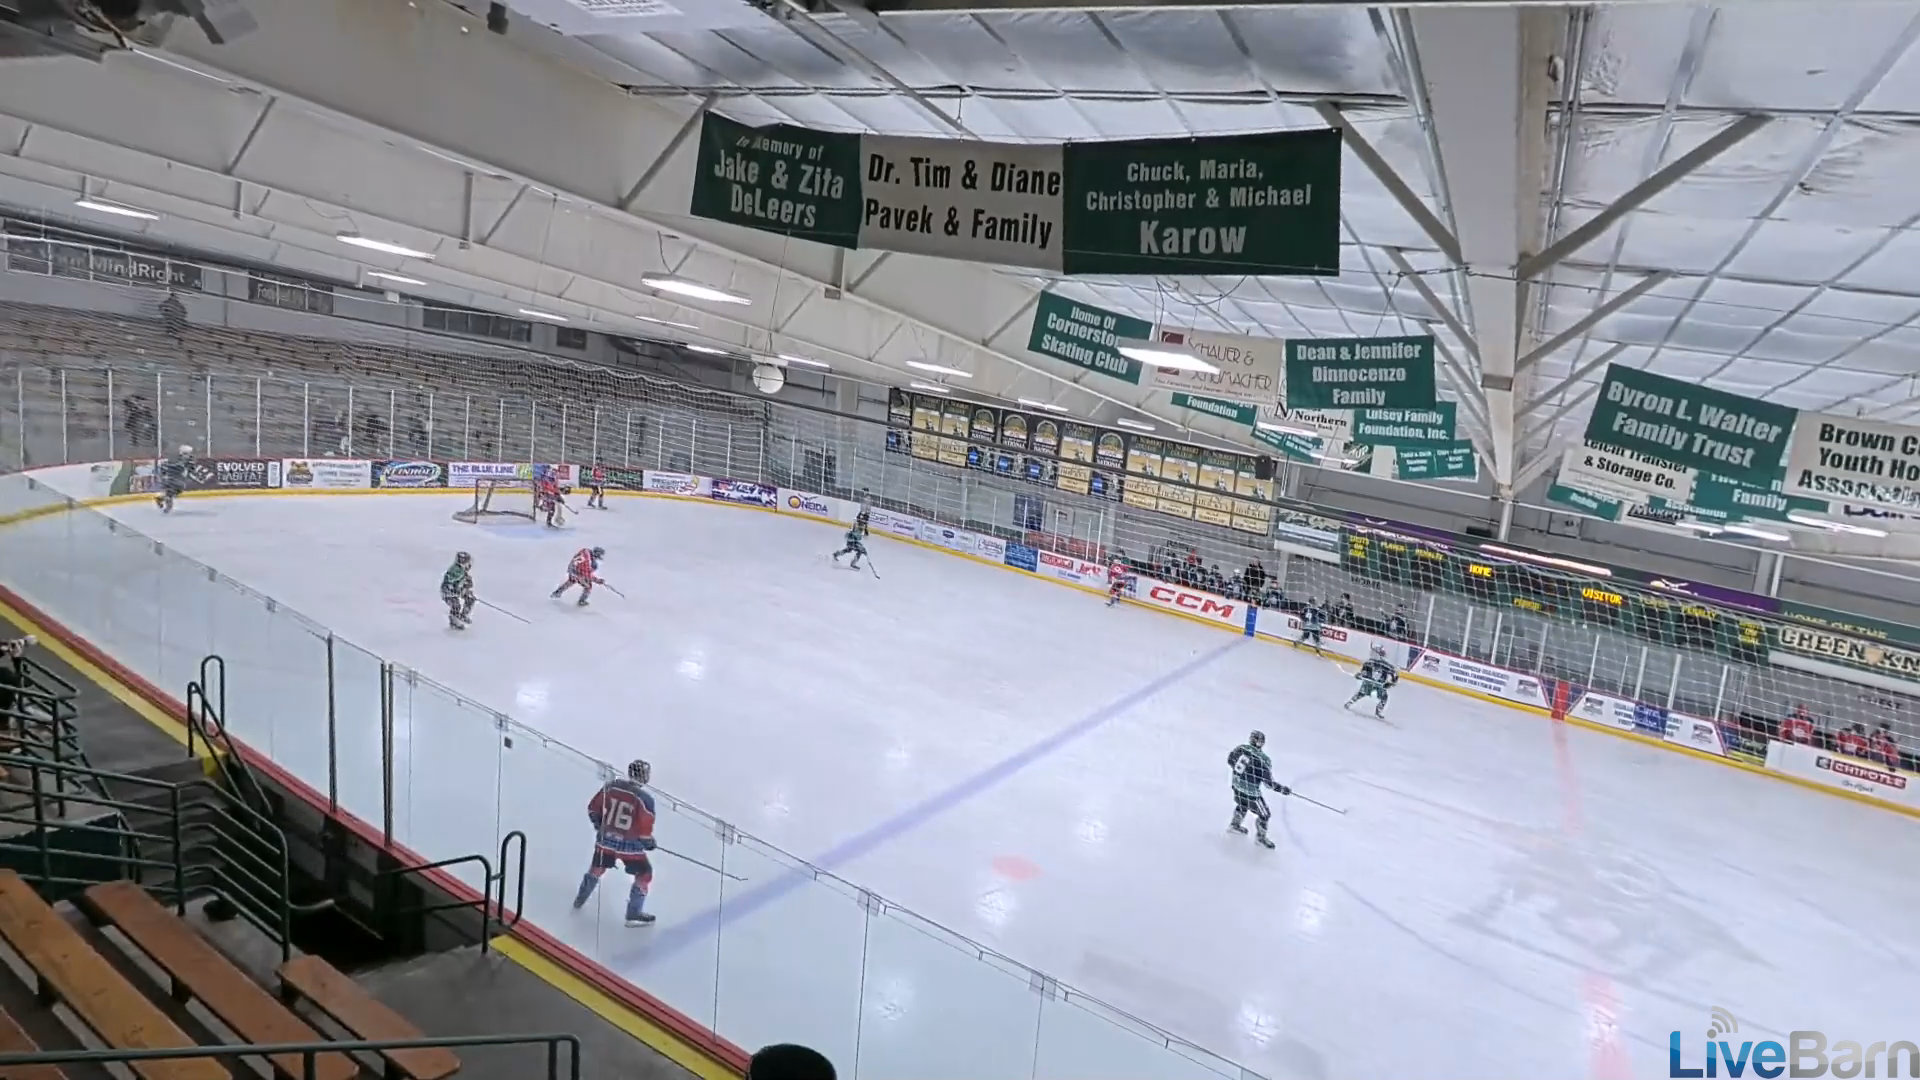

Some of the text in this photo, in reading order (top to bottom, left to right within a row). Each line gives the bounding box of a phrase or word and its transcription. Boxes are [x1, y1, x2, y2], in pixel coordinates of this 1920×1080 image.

[808, 145, 825, 161] of
[714, 149, 844, 199] Jake & Zita
[868, 153, 1061, 196] Dr. Tim & Diane
[1126, 158, 1264, 184] Chuck, Maria,
[730, 183, 817, 228] DeLeers
[1086, 184, 1312, 212] Christopher & Michael
[865, 198, 1053, 249] Pavek & Family
[1140, 220, 1247, 255] Karow
[1070, 306, 1117, 331] Home Of
[1041, 333, 1129, 375] Skating Club
[1296, 343, 1422, 361] Dean & Jennifer
[1312, 366, 1407, 383] Dinnocenzo
[1187, 396, 1238, 418] Foundation
[1332, 388, 1386, 405] Family
[1295, 410, 1347, 427] Northern
[1404, 410, 1444, 425] Family
[1607, 380, 1783, 443] Byron L. Walter
[1427, 427, 1450, 440] Inc.
[1612, 411, 1756, 469] Family Trust
[1819, 423, 1896, 452] Brown
[216, 461, 265, 472] EVOLVED
[452, 464, 515, 474] THE BLUE LINE
[1583, 455, 1676, 490] & Storage Co.
[1820, 447, 1884, 476] Youth
[217, 472, 263, 481] HABITAT
[1732, 488, 1788, 511] Family
[1469, 564, 1492, 577] HOME
[1150, 585, 1235, 618] CCM
[1582, 588, 1623, 605] VISITOR
[1835, 764, 1903, 787] CHIPOTLE
